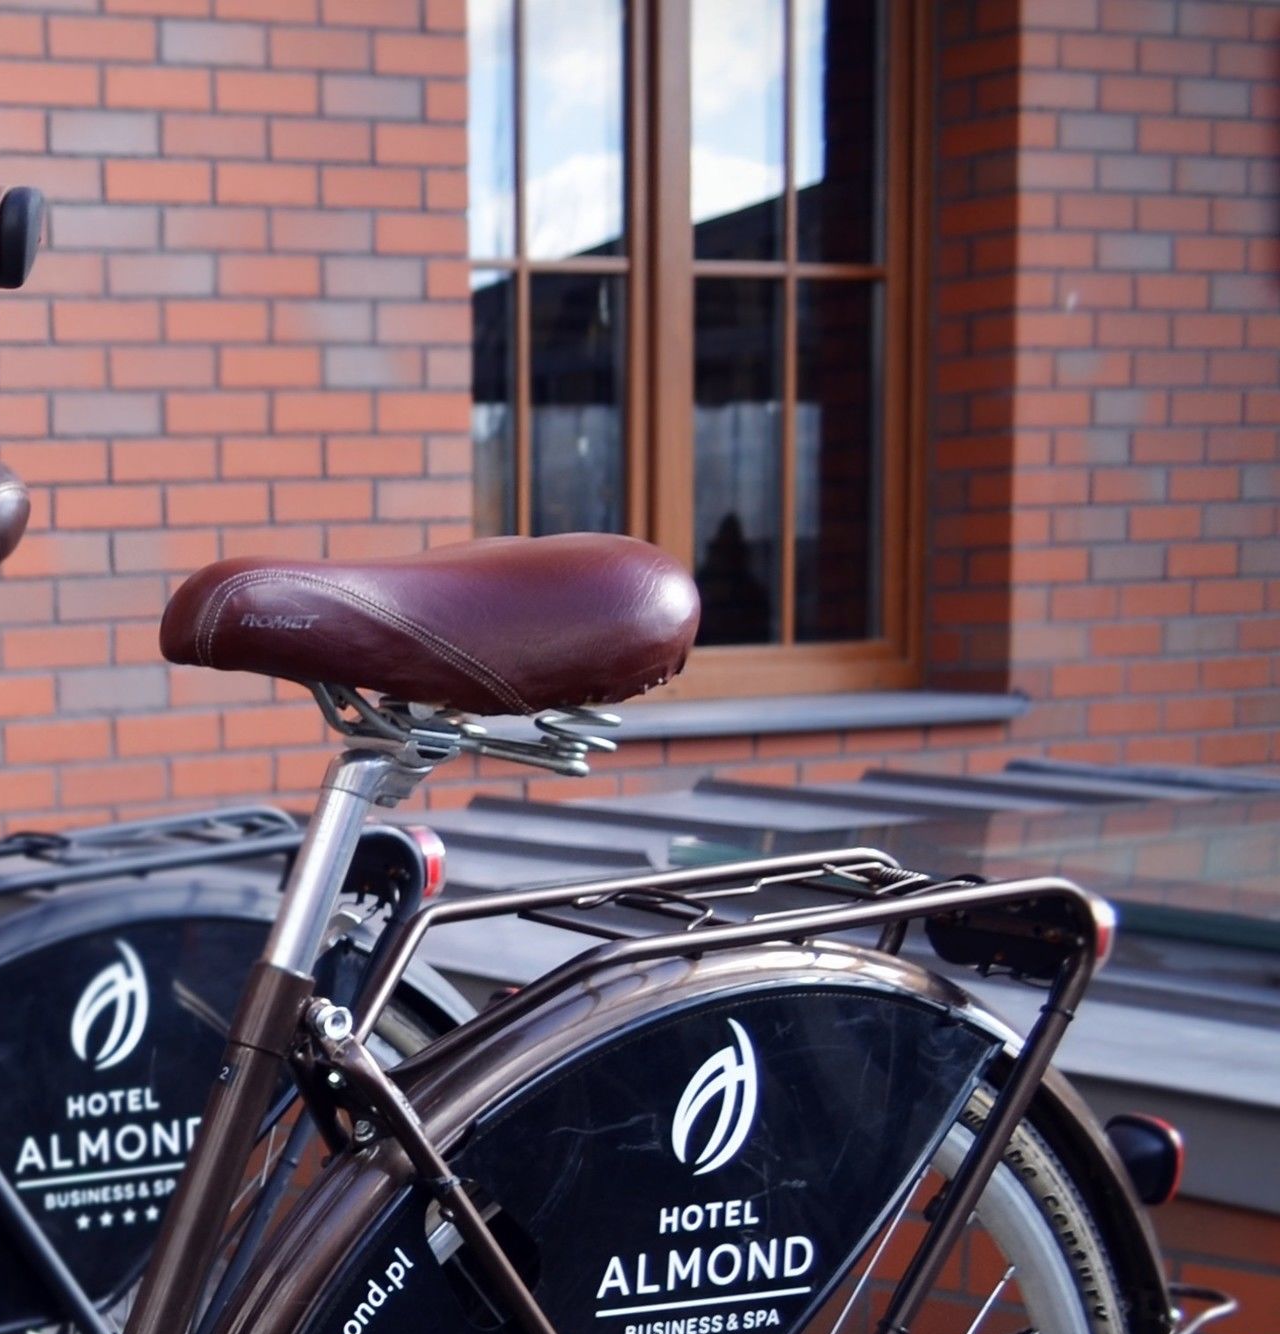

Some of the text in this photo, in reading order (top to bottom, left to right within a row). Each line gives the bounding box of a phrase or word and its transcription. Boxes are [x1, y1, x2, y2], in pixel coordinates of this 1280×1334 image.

[219, 1066, 230, 1080] 2
[66, 1086, 160, 1119] HOTEL
[44, 1177, 176, 1211] BUSINESS & SP
[658, 1199, 760, 1234] HOTEL
[595, 1235, 815, 1299] ALMOND
[725, 1312, 739, 1331] &
[742, 1308, 781, 1330] SPA
